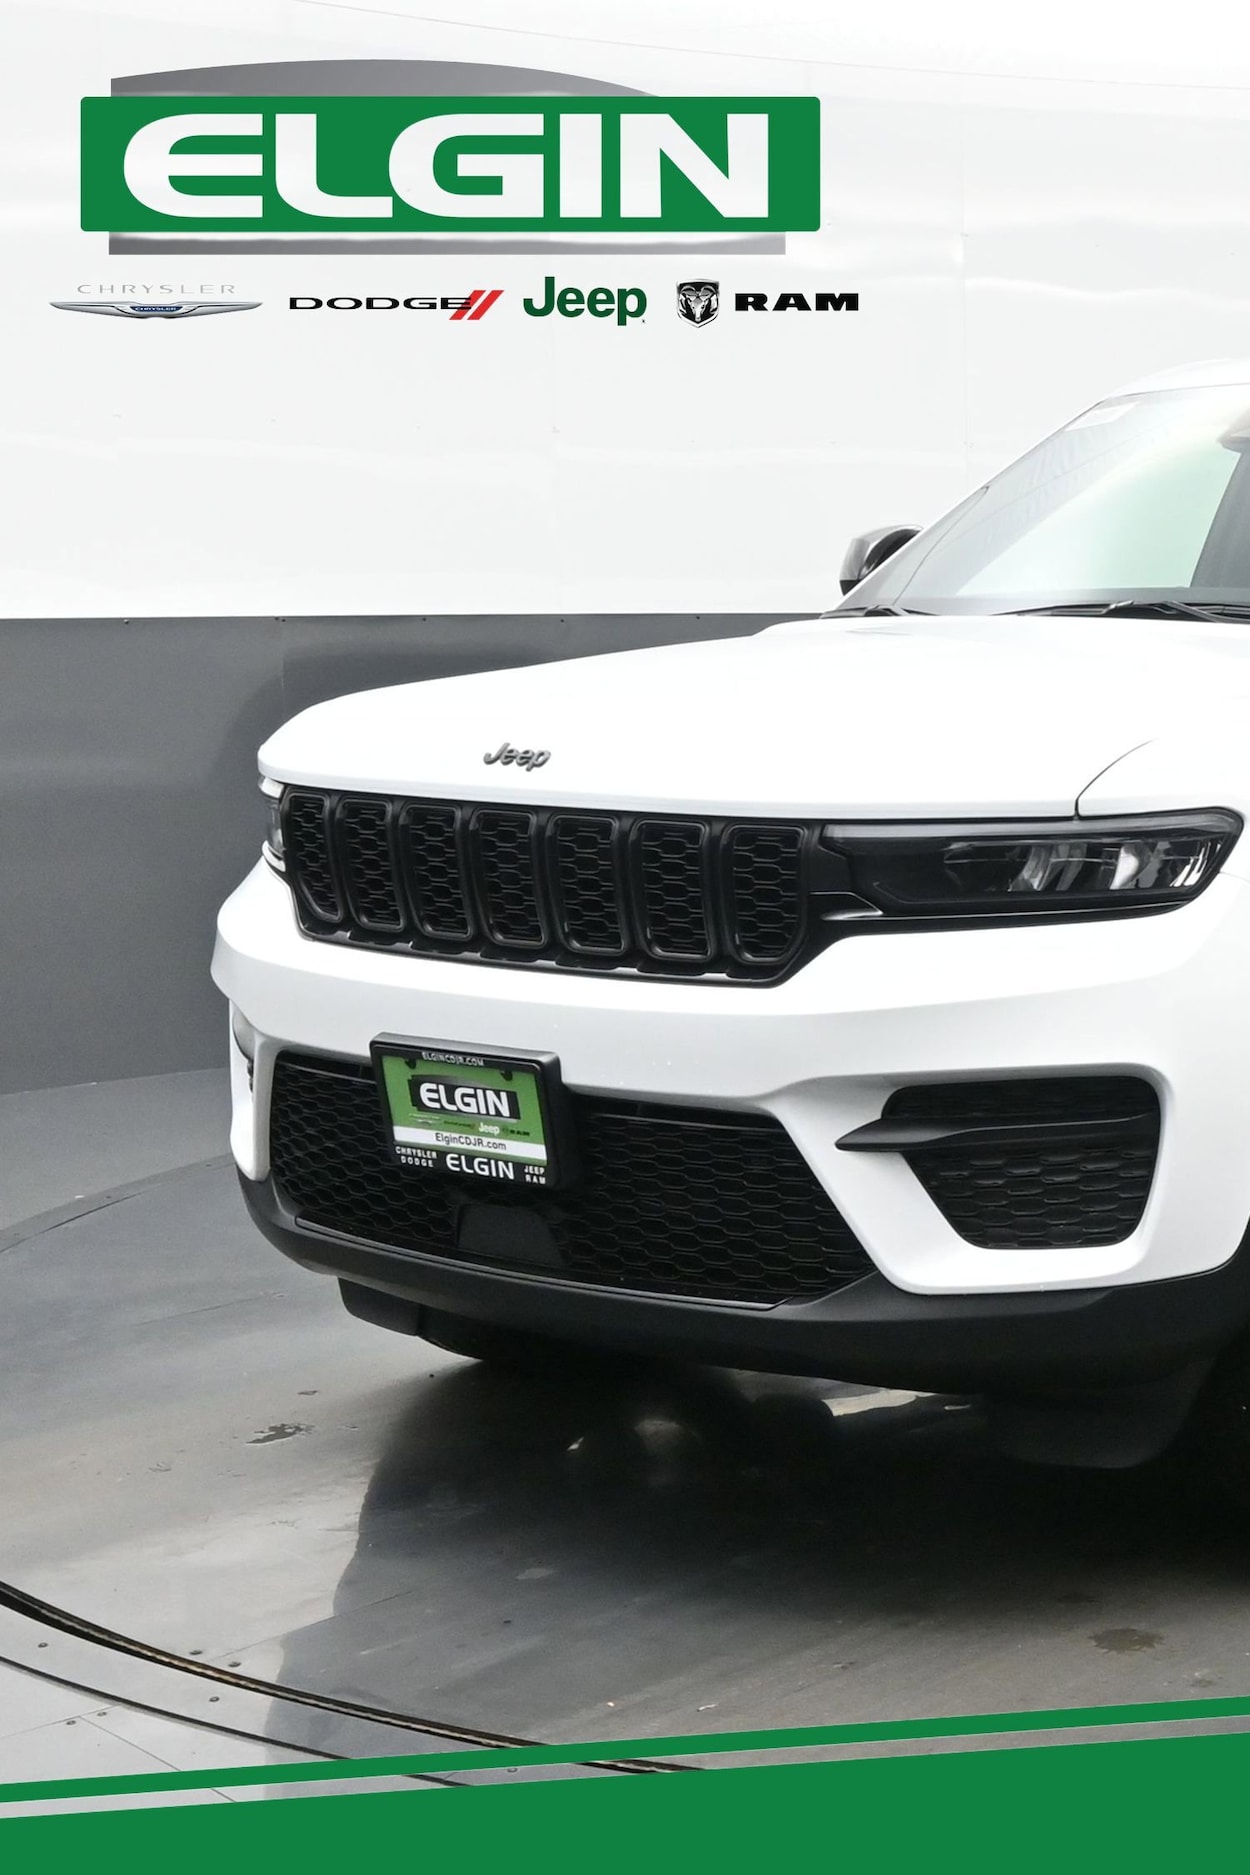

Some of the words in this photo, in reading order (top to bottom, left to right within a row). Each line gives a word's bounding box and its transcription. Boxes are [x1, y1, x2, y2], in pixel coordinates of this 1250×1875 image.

[483, 742, 551, 772] Jeep
[421, 1051, 485, 1067] ELGINCDJR.COM
[419, 1082, 510, 1117] ELGIN
[478, 1122, 500, 1136] Jeep
[435, 1132, 507, 1151] ElginCDJR.com
[395, 1146, 438, 1159] CHRYSLER
[400, 1155, 434, 1168] DODGE
[445, 1154, 515, 1180] ELGIN
[524, 1165, 546, 1175] JEEP
[525, 1174, 547, 1185] RAM
